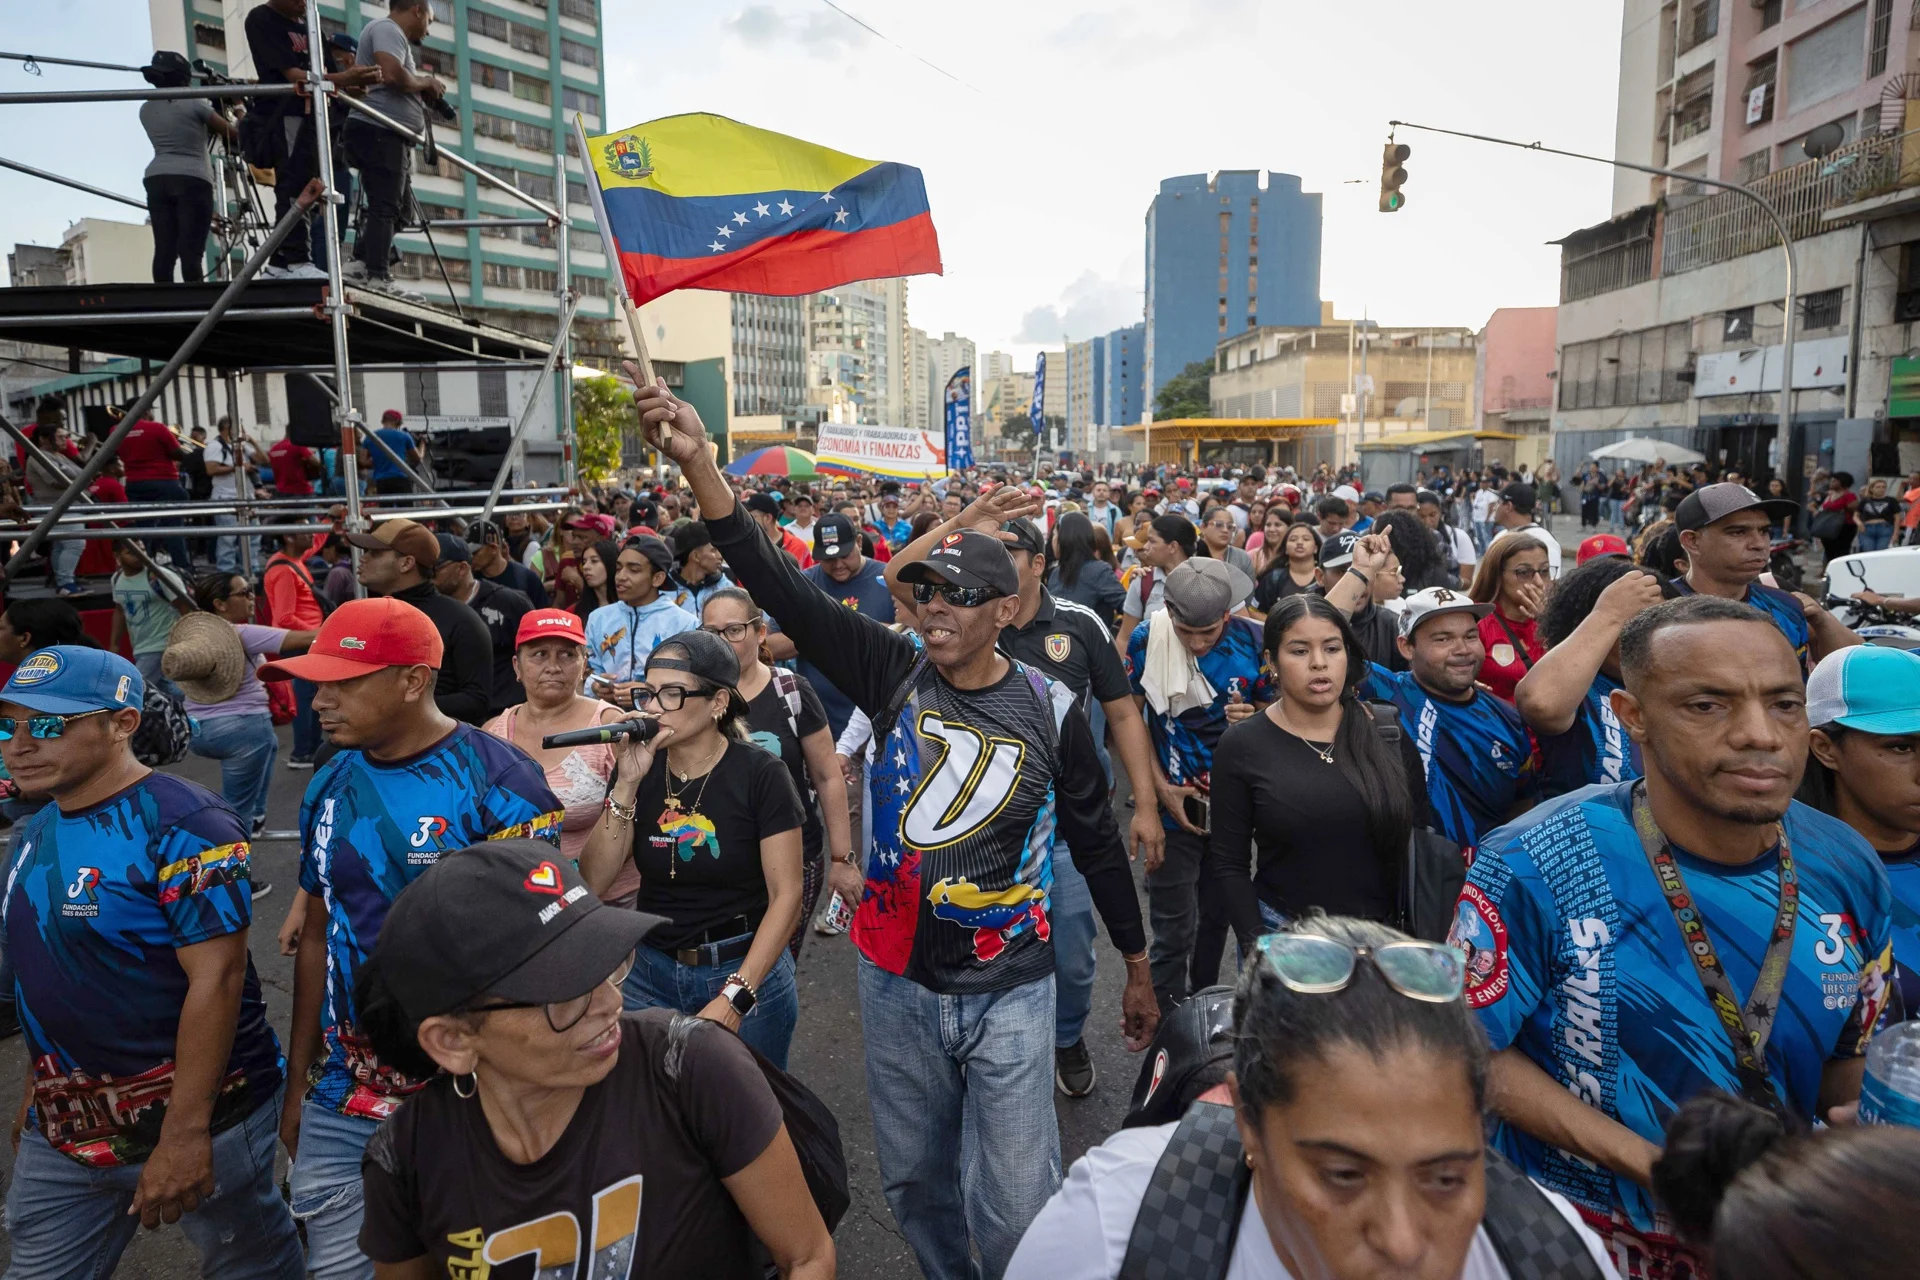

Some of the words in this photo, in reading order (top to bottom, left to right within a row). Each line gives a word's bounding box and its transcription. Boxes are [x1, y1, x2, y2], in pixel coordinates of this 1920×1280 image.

[870, 441, 921, 459] FINANZAS
[1519, 823, 1543, 842] TRES
[1545, 806, 1581, 825] RAICES
[1530, 822, 1564, 845] RAICES
[1569, 812, 1586, 824] TRE
[1529, 838, 1551, 857] TRES
[1553, 822, 1587, 842] RAICES
[1540, 839, 1571, 864] RAICES
[1575, 830, 1592, 842] TRE
[1562, 838, 1594, 859] RAICES
[407, 851, 441, 859] FUNDACIÓ
[1582, 847, 1599, 860] TRE
[1588, 864, 1605, 877] TRE
[1595, 884, 1611, 895] TRE
[62, 903, 98, 911] FUNDACIÓN
[538, 901, 564, 925] AMOR
[1463, 884, 1505, 933] UNDACIÓN
[1600, 902, 1617, 914] TRE
[1653, 853, 1682, 892] THE
[1671, 893, 1717, 969] DOCTOR
[1477, 968, 1508, 1003] ENERO
[1821, 973, 1860, 982] FUNDAC
[1823, 983, 1845, 995] TRES
